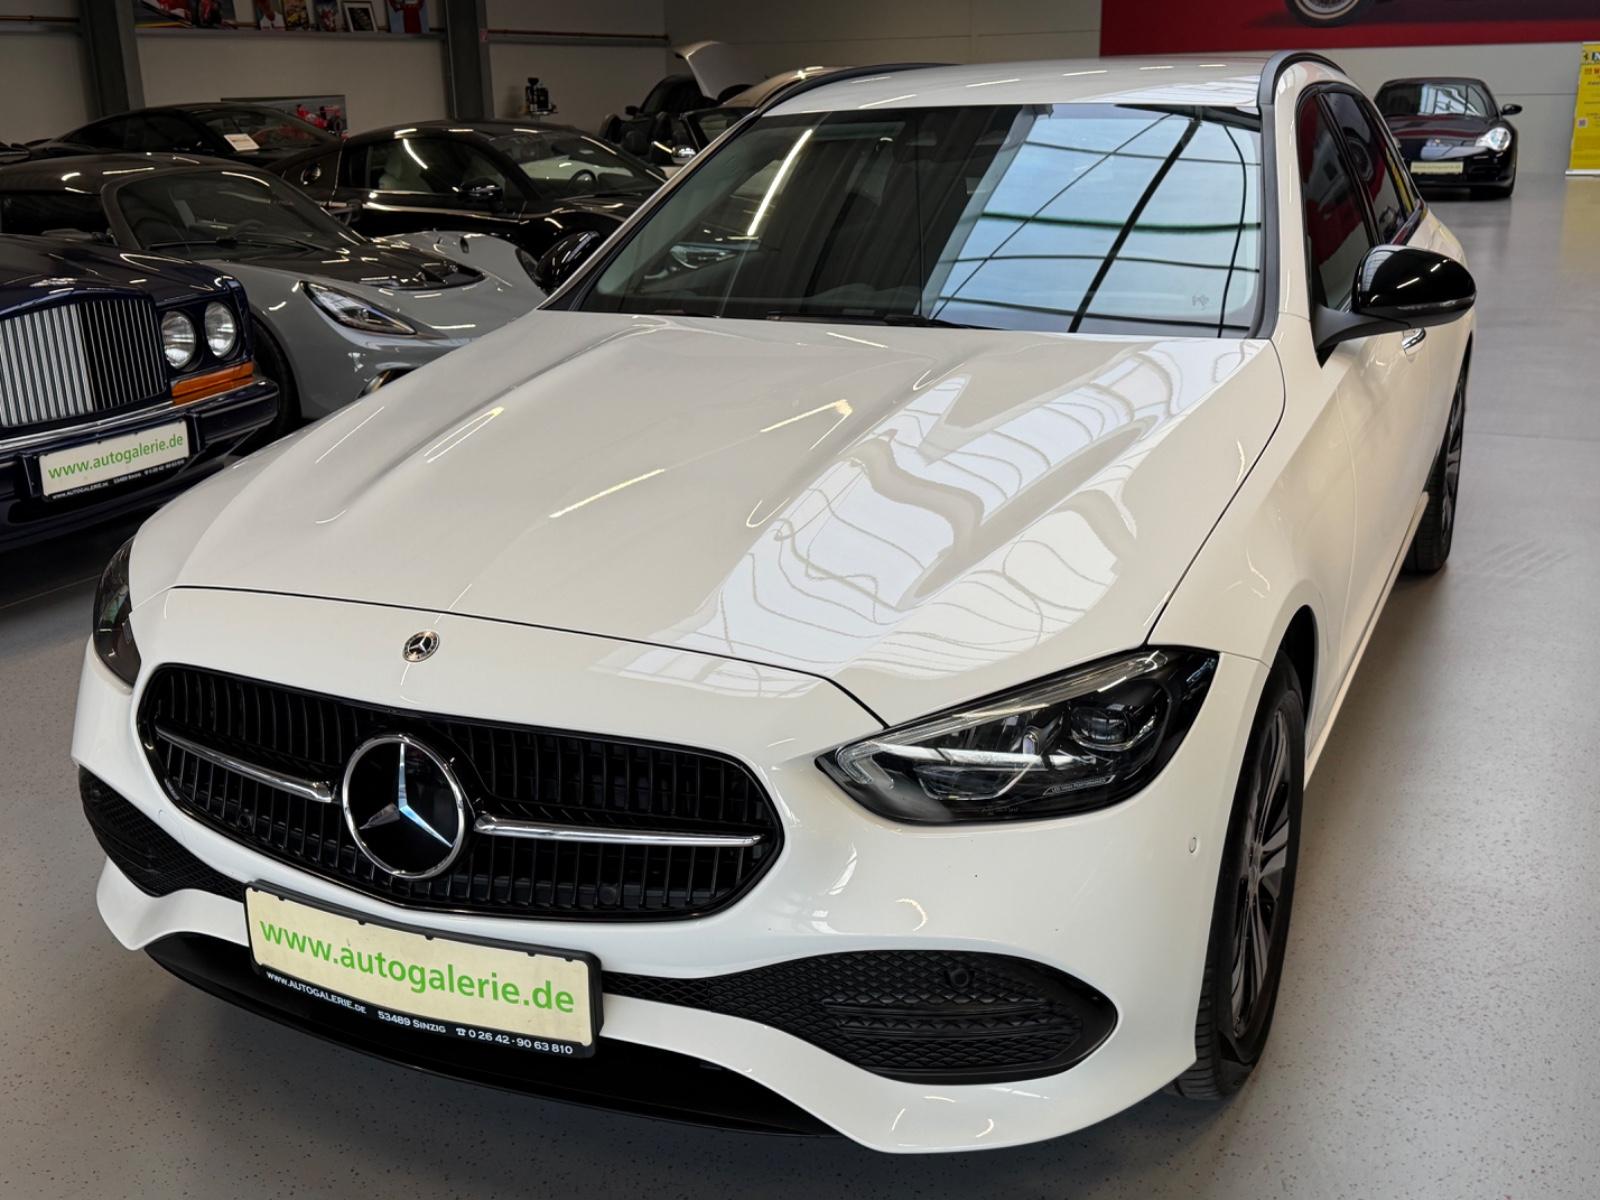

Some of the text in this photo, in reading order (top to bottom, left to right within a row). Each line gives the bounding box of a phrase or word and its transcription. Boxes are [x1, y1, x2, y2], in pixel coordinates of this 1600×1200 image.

[48, 434, 183, 479] www.autogalerie.de
[259, 920, 575, 1013] www.autogalerie.de
[266, 971, 367, 1014] www.AUTOGALERIE.DE
[377, 1010, 411, 1026] 53489
[534, 1041, 549, 1051] 63
[551, 1044, 573, 1054] 810
